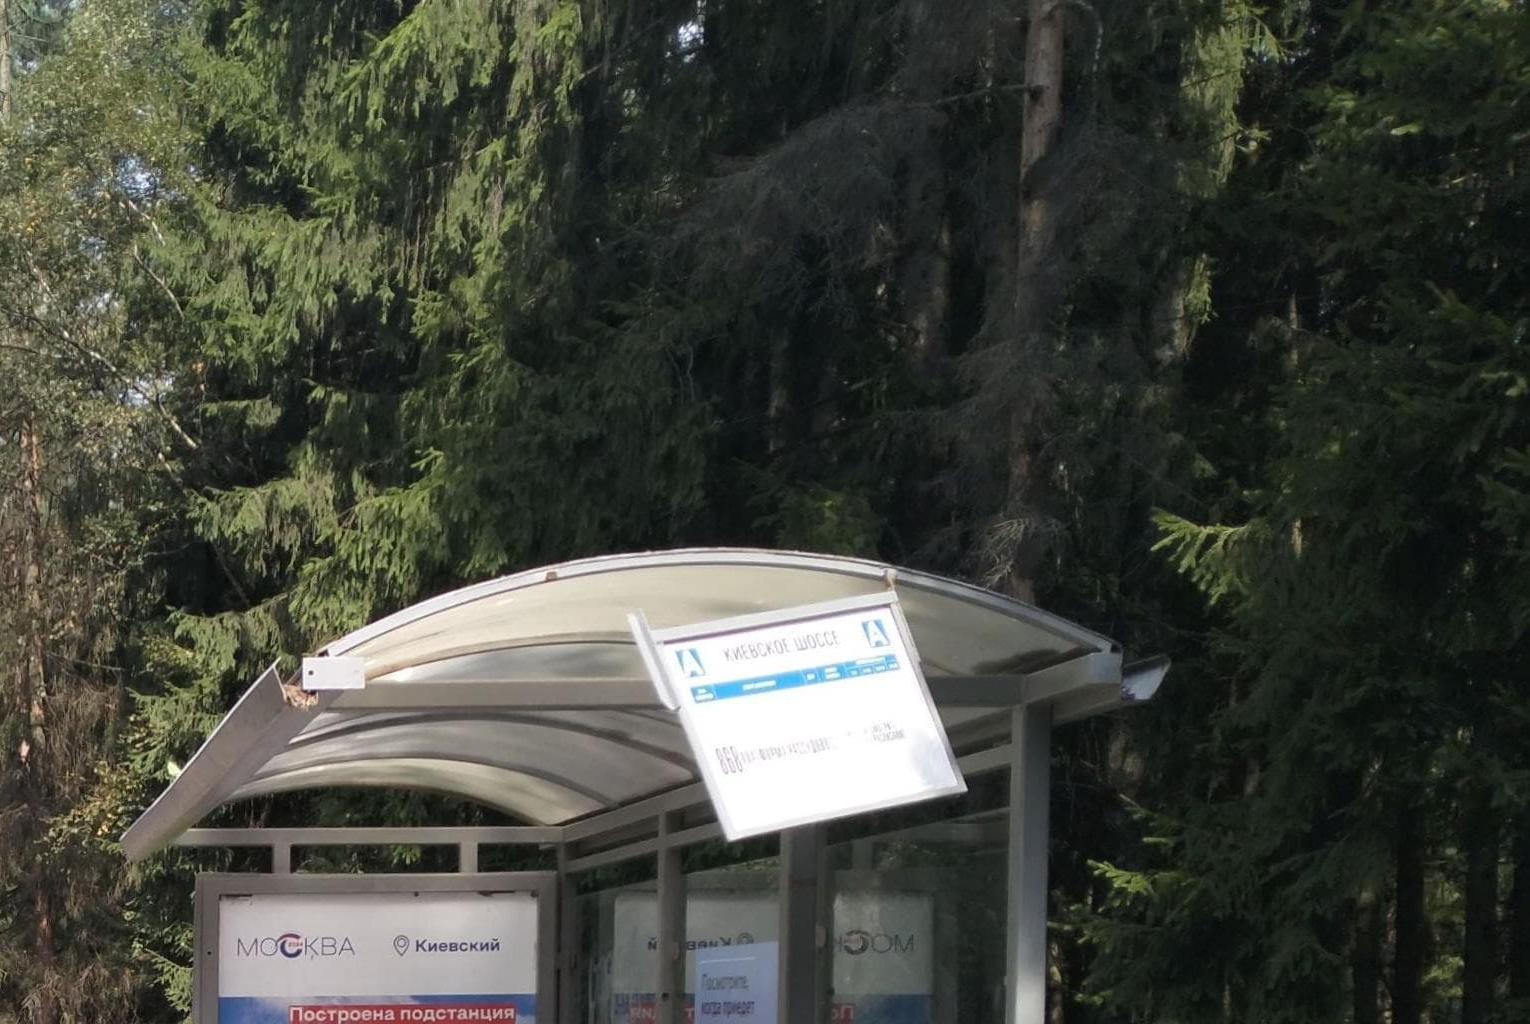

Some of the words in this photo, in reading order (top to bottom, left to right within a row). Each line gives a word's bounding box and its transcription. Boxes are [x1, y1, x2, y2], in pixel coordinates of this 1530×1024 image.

[723, 638, 790, 662] КИЕВСКОЕ
[793, 630, 839, 651] ШОССЕ
[237, 933, 355, 958] МОСКВА
[415, 938, 500, 953] Киевский
[289, 1006, 395, 1024] Построена
[400, 1006, 515, 1023] подстанция
